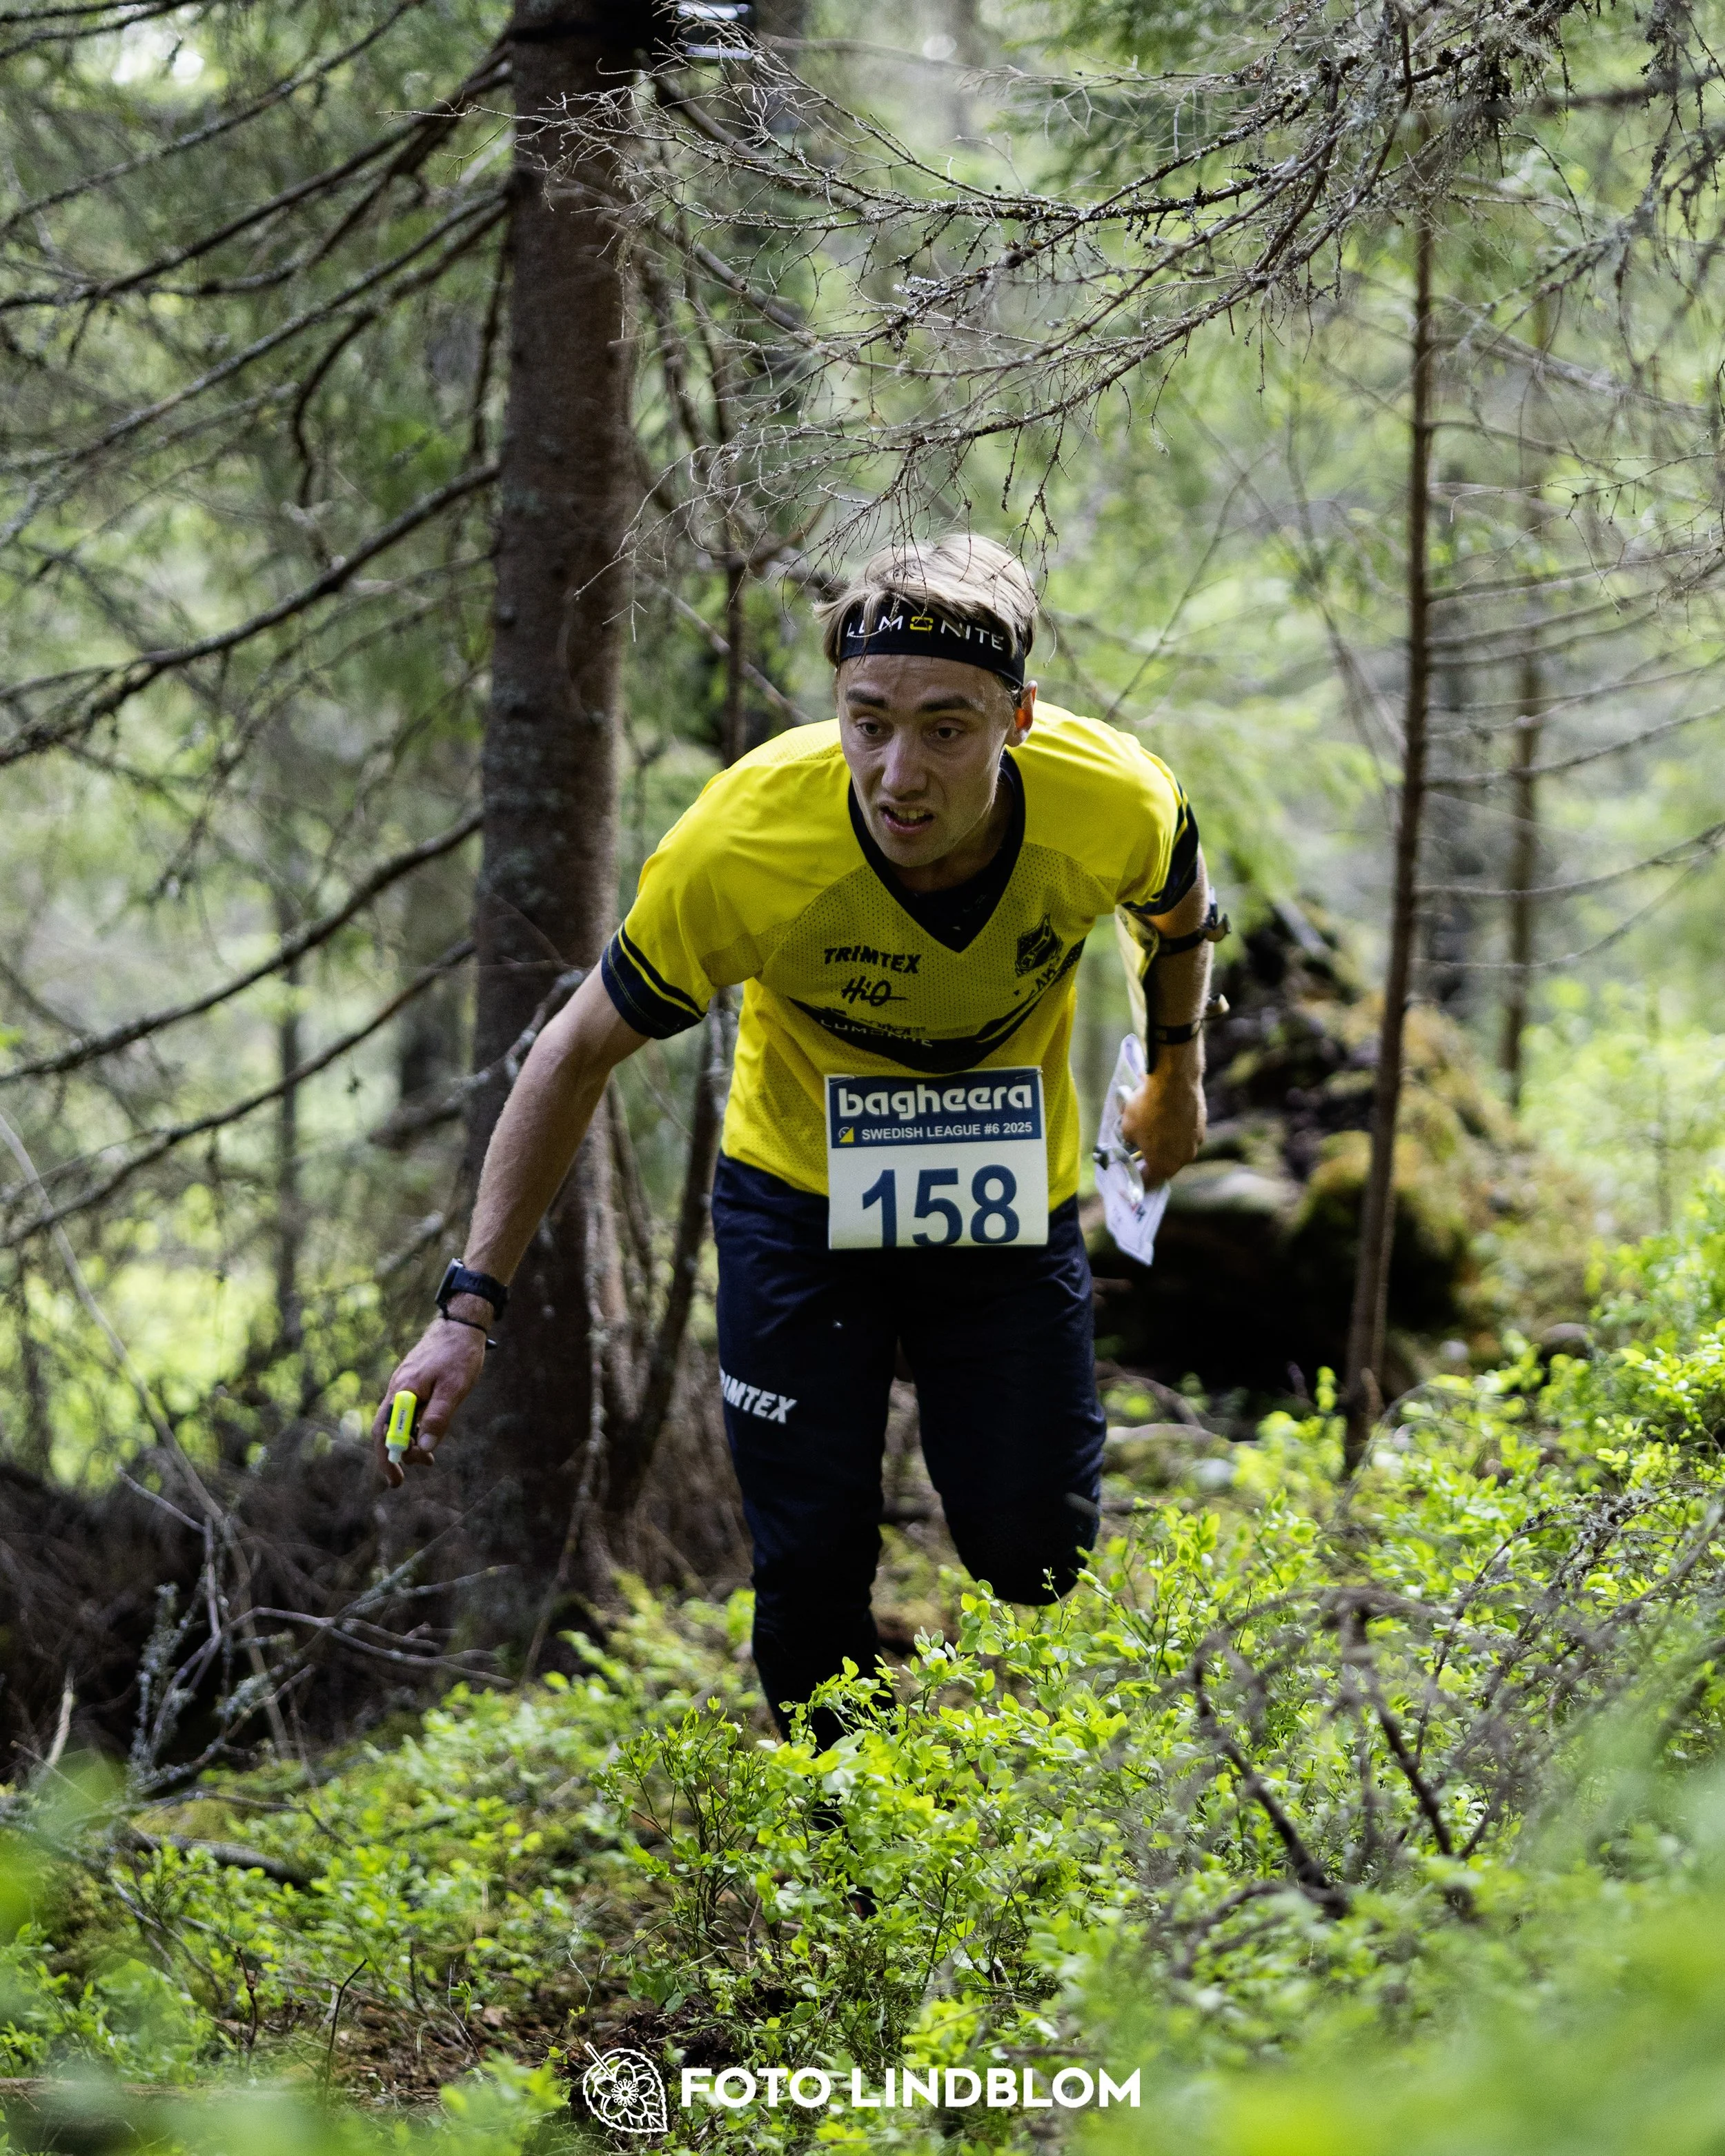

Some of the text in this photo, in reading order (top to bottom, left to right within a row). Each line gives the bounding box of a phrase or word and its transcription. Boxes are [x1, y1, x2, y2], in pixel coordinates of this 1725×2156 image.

[824, 945, 922, 973] TRIMTEX
[820, 1019, 933, 1047] LUMONE
[838, 1084, 1033, 1120] bagheera
[862, 1121, 1033, 1140] SWEDISH LEAGUE #6 2025
[862, 1164, 1020, 1248] 158
